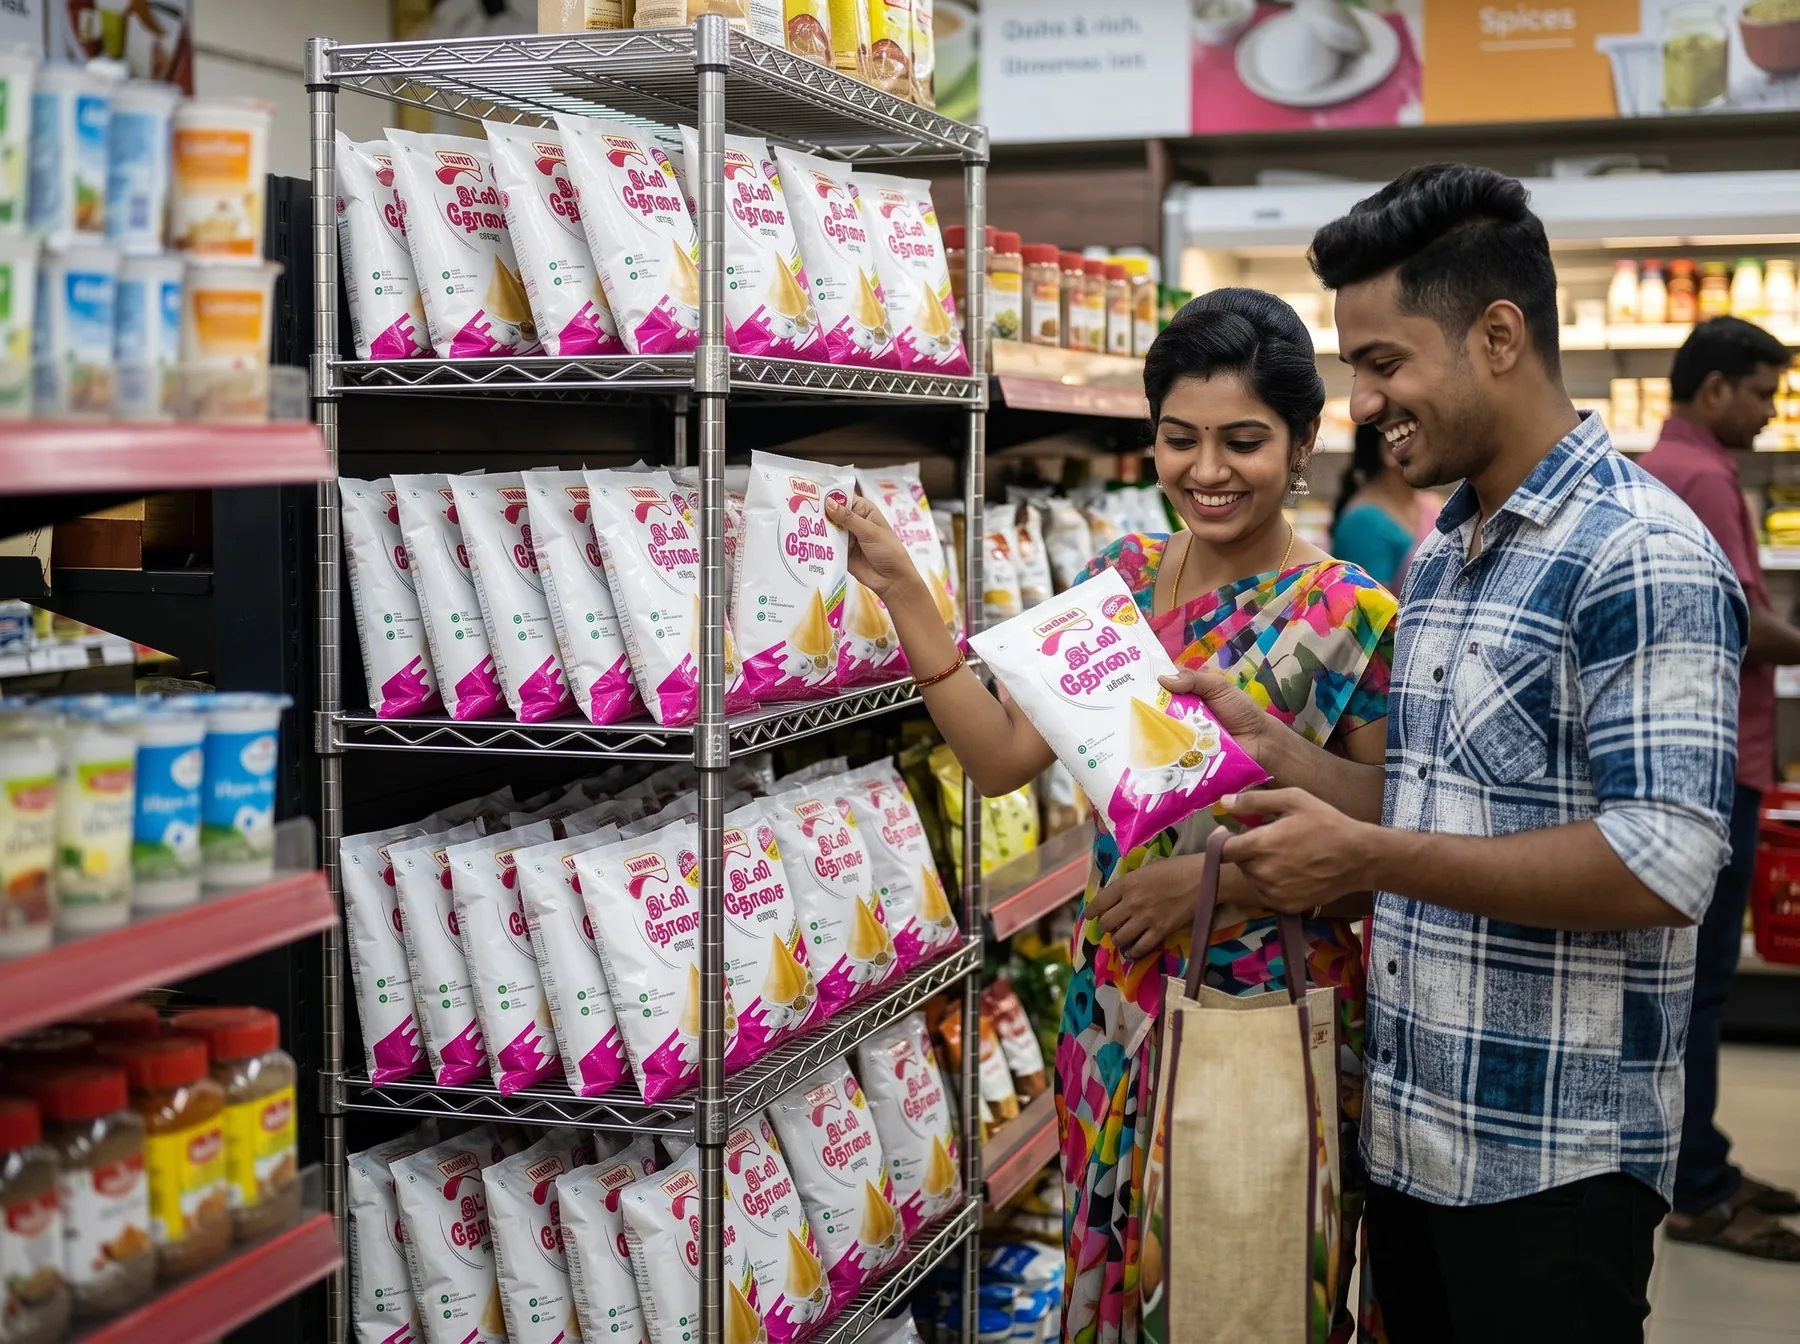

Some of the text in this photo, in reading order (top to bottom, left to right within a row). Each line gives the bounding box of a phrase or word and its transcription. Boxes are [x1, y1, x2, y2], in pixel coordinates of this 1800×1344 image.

[1479, 5, 1576, 38] Spices
[785, 531, 836, 564] தோசை
[1059, 645, 1142, 696] தோசை
[729, 858, 772, 893] இட்லி
[814, 850, 863, 882] தோசை
[723, 882, 785, 921] தோசை
[821, 1130, 872, 1171] தோசை
[741, 1176, 792, 1219] தோசை
